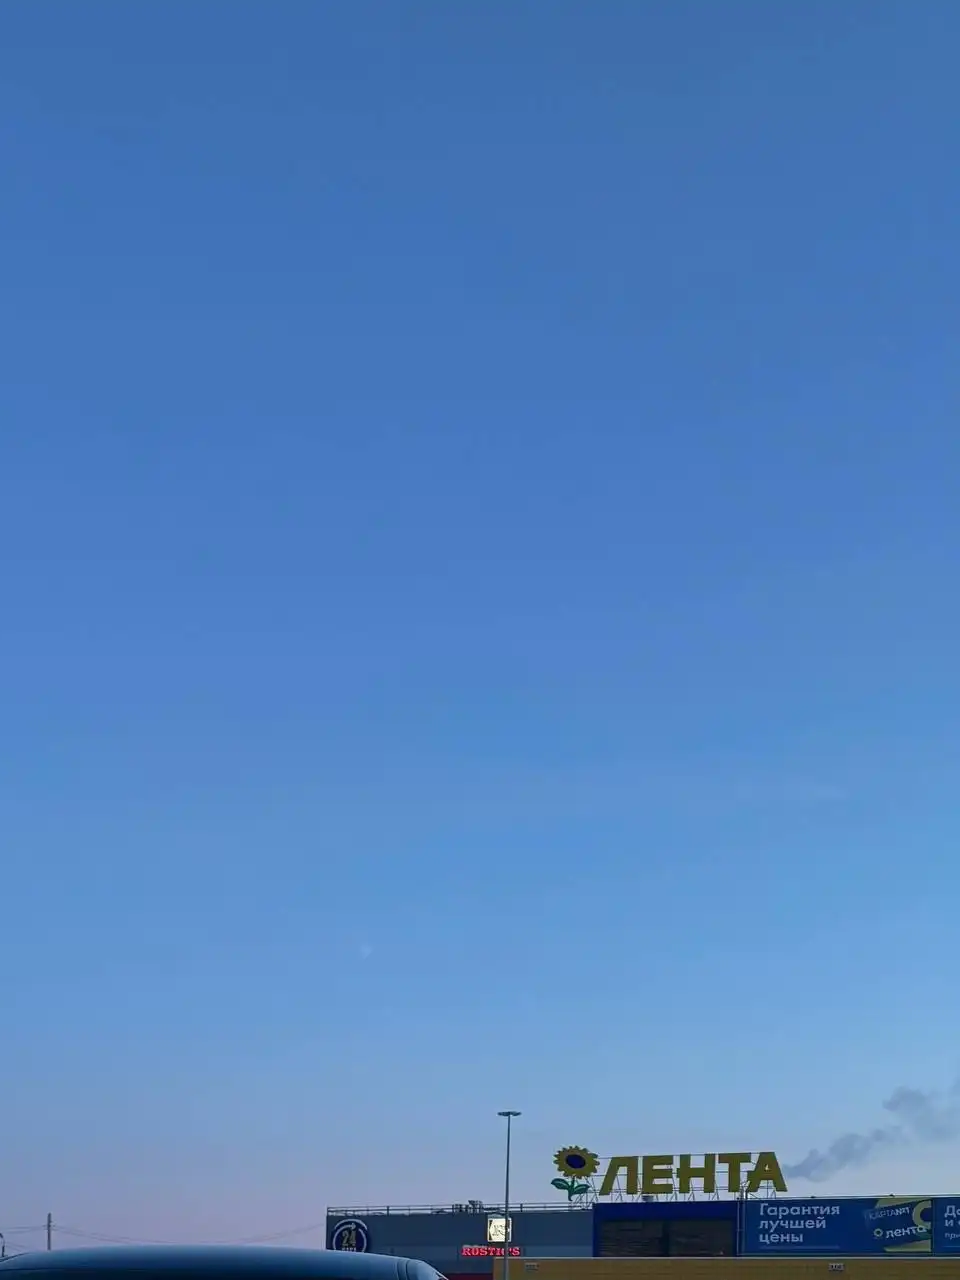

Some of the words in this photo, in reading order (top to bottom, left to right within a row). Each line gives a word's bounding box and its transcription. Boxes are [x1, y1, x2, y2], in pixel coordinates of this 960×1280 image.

[599, 1152, 787, 1196] ЛЕНТА
[759, 1203, 840, 1219] Гарантия
[759, 1216, 827, 1232] лучшей
[885, 1225, 928, 1239] лента
[342, 1230, 357, 1247] 24
[759, 1233, 804, 1244] цены
